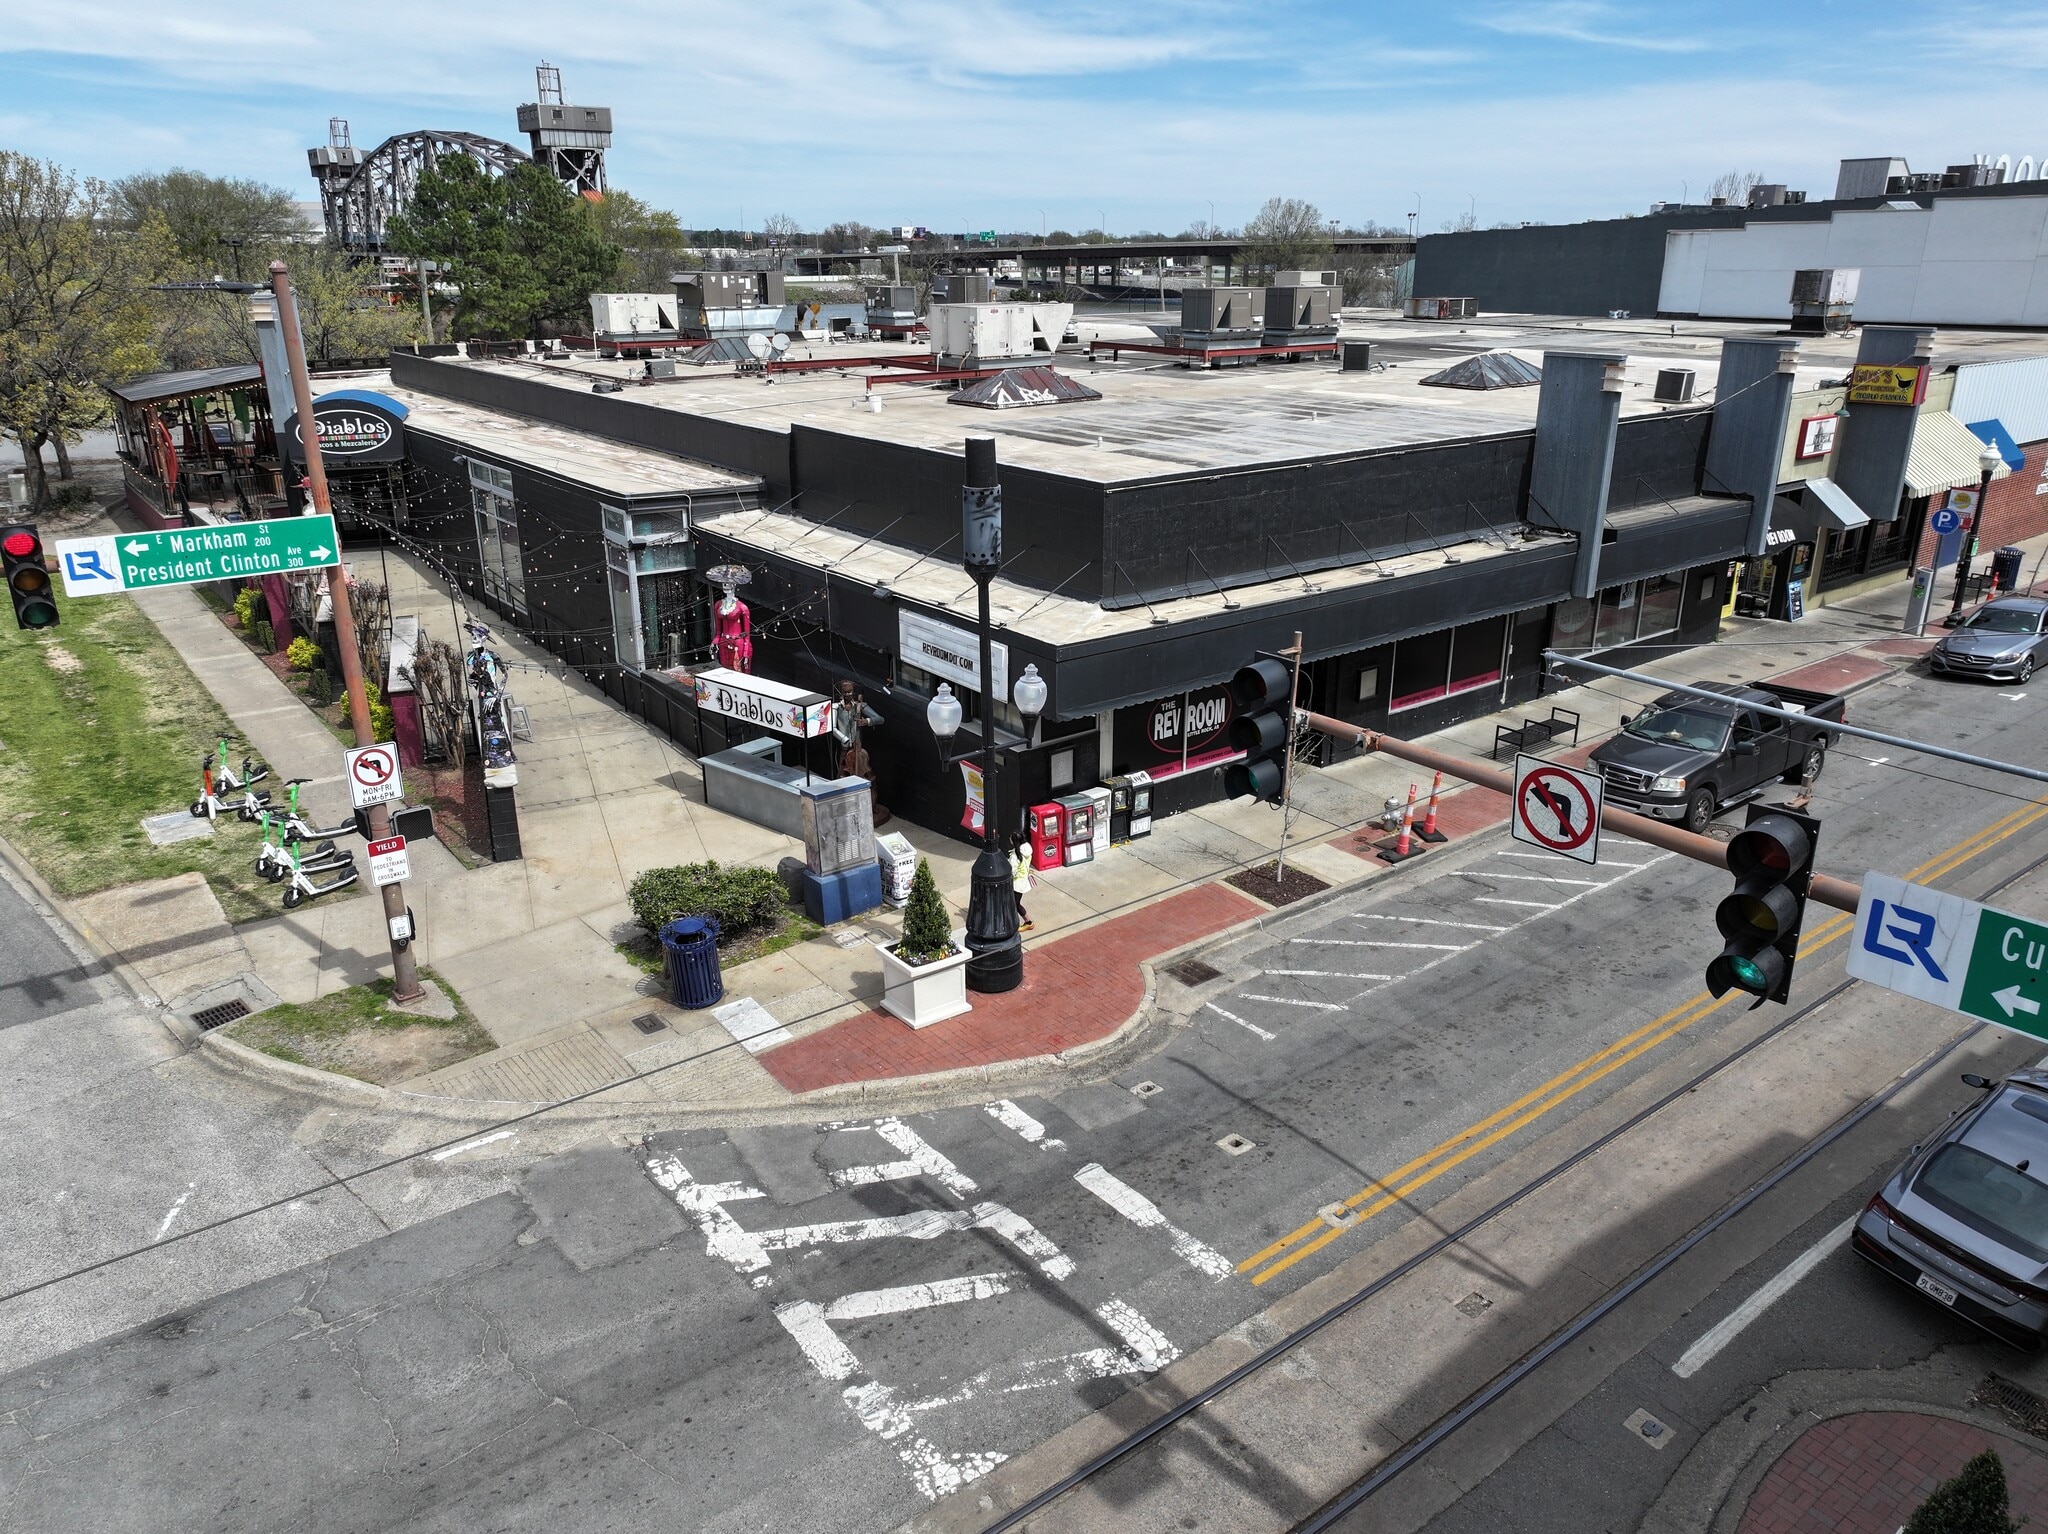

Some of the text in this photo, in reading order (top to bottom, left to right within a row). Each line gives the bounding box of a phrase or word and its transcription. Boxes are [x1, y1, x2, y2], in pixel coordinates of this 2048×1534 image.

[1937, 511, 1952, 528] P
[258, 525, 270, 535] St
[156, 530, 248, 554] E Markham
[254, 536, 272, 547] 200
[287, 545, 302, 556] Ave
[126, 551, 281, 585] President Clinton
[287, 557, 304, 568] 300
[716, 687, 784, 728] Diablos
[1161, 700, 1177, 711] THE
[1153, 697, 1226, 741] REV ROOM
[362, 784, 393, 796] MON-FRI
[362, 791, 396, 804] 6AM-6PM
[375, 840, 398, 852] YIELD
[373, 858, 407, 870] PEDESTRIANS
[377, 870, 407, 881] CROSSWALK
[2001, 926, 2048, 974] Cu
